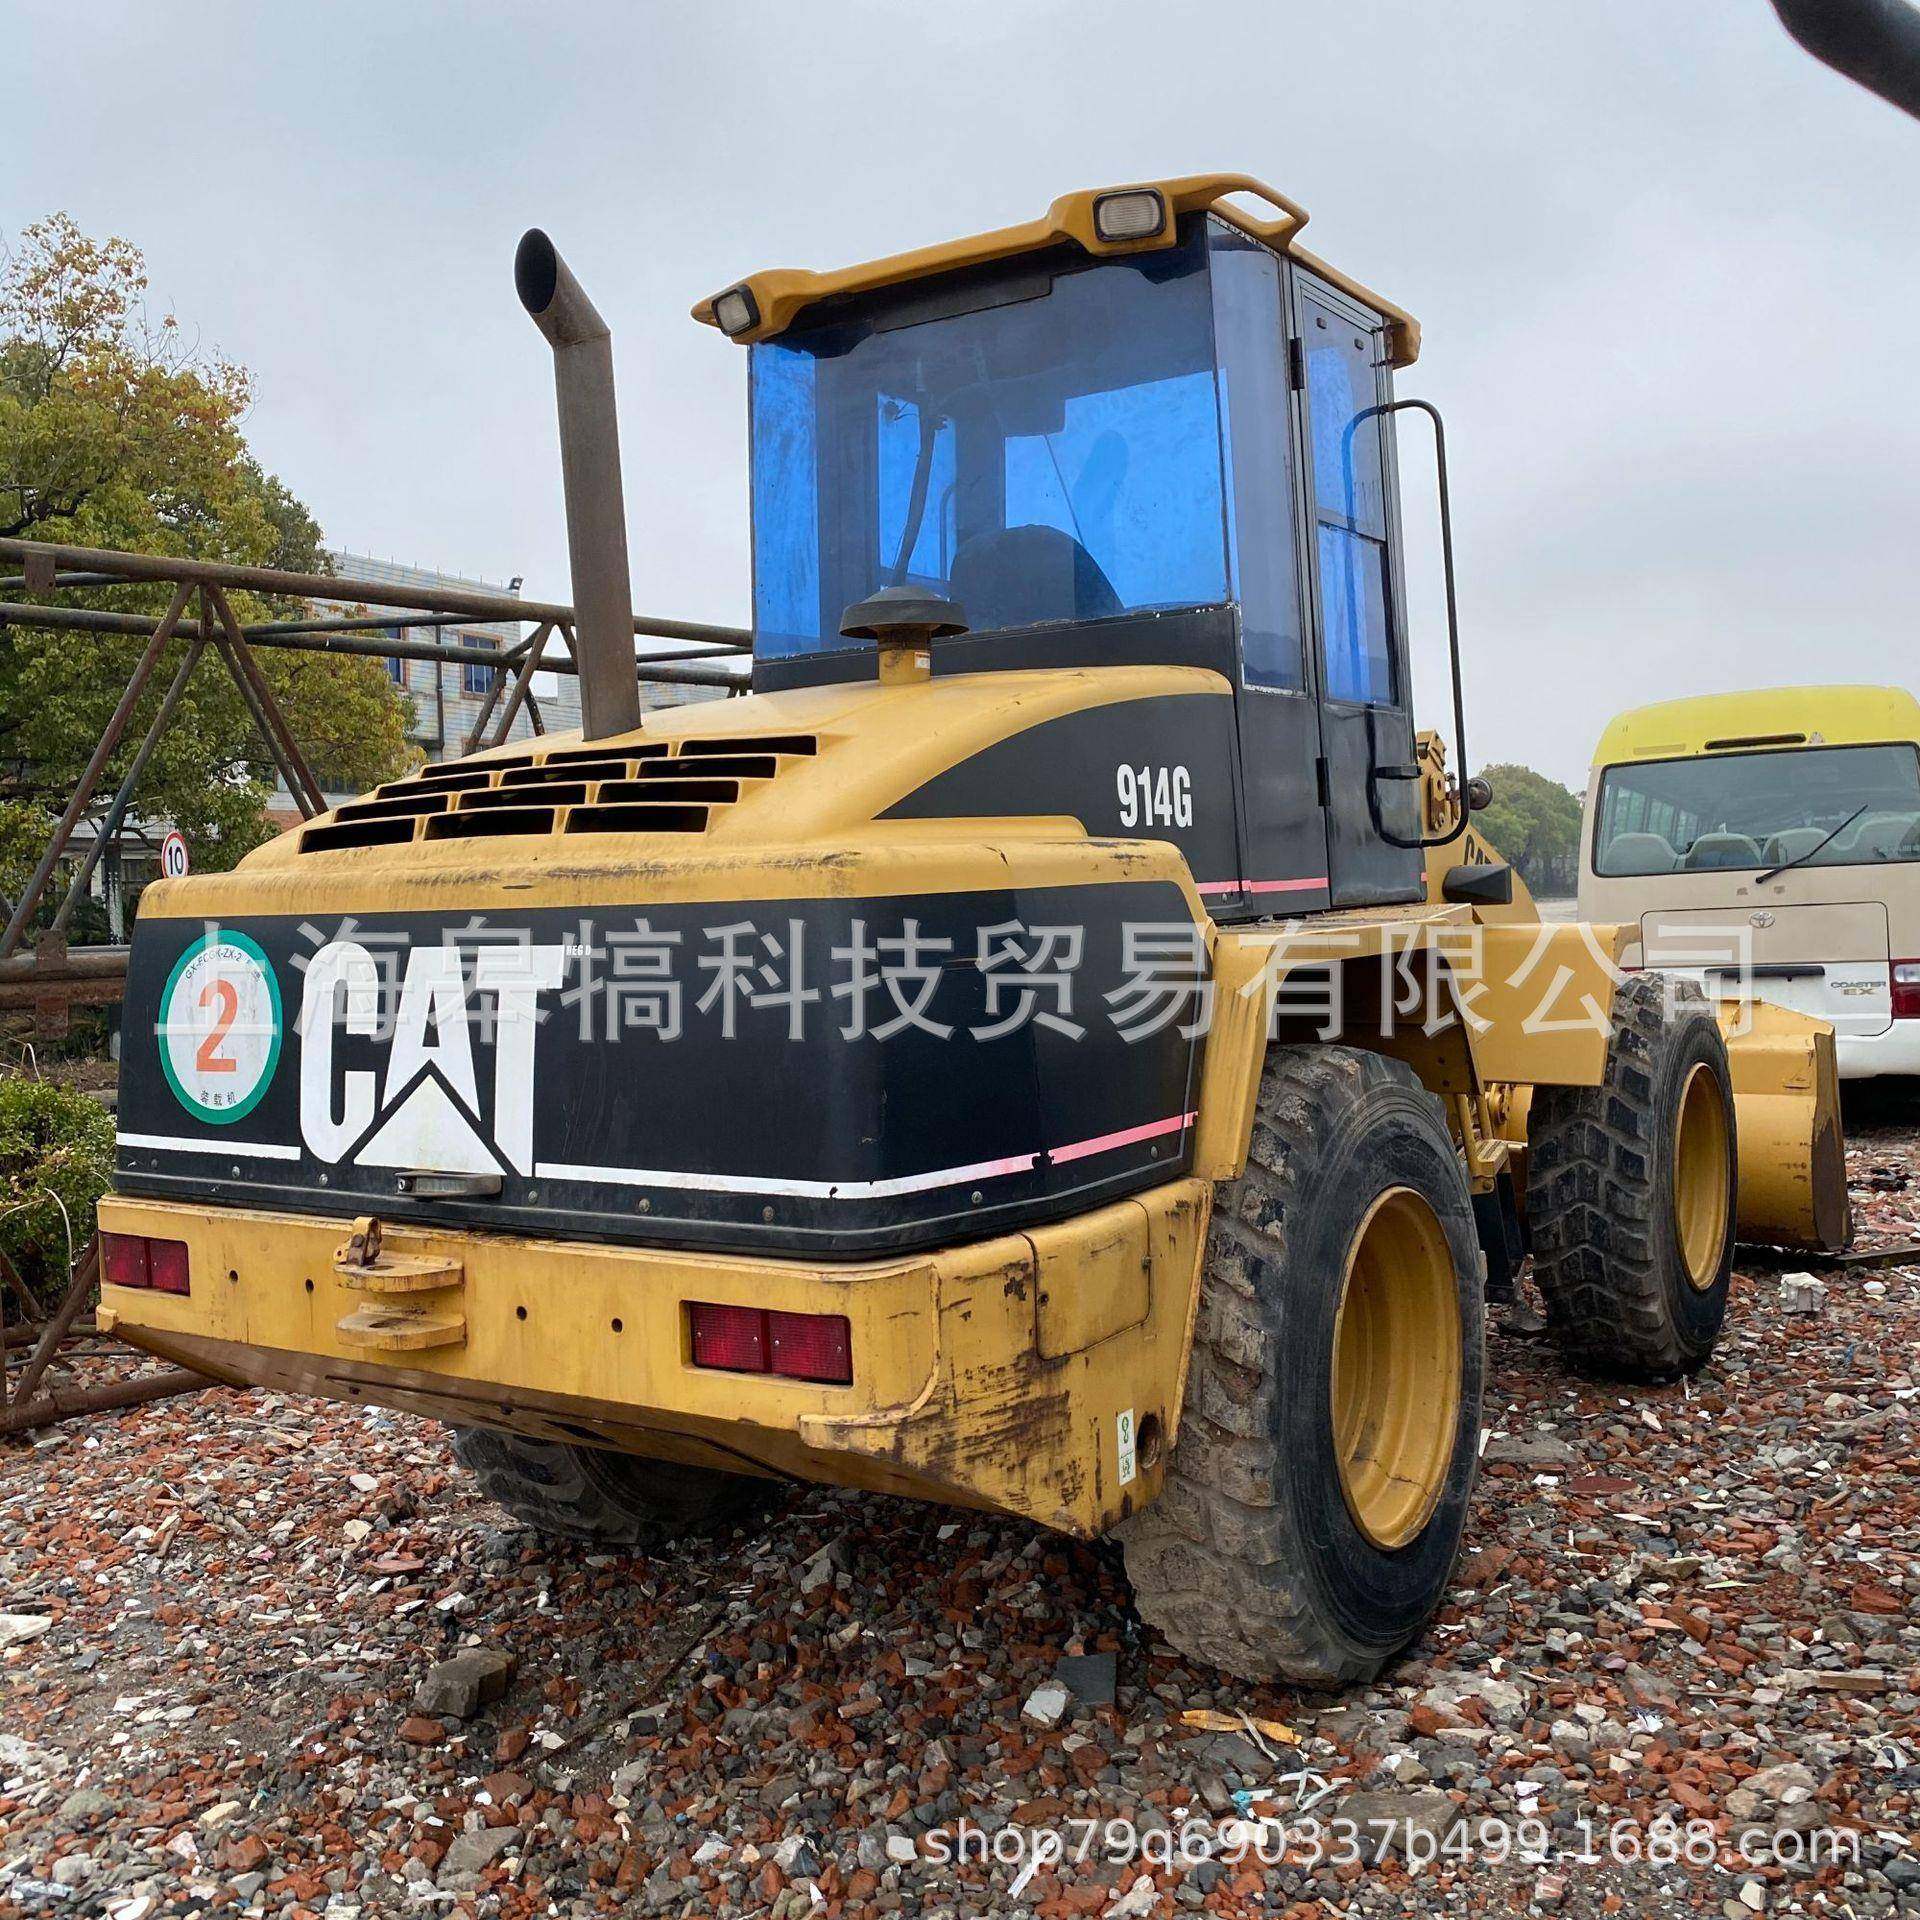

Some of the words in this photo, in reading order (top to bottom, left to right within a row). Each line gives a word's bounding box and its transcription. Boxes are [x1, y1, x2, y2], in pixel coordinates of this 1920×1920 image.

[1117, 764, 1192, 828] 914G
[168, 846, 184, 875] 10
[196, 979, 238, 1073] 2
[300, 941, 565, 1177] CAT
